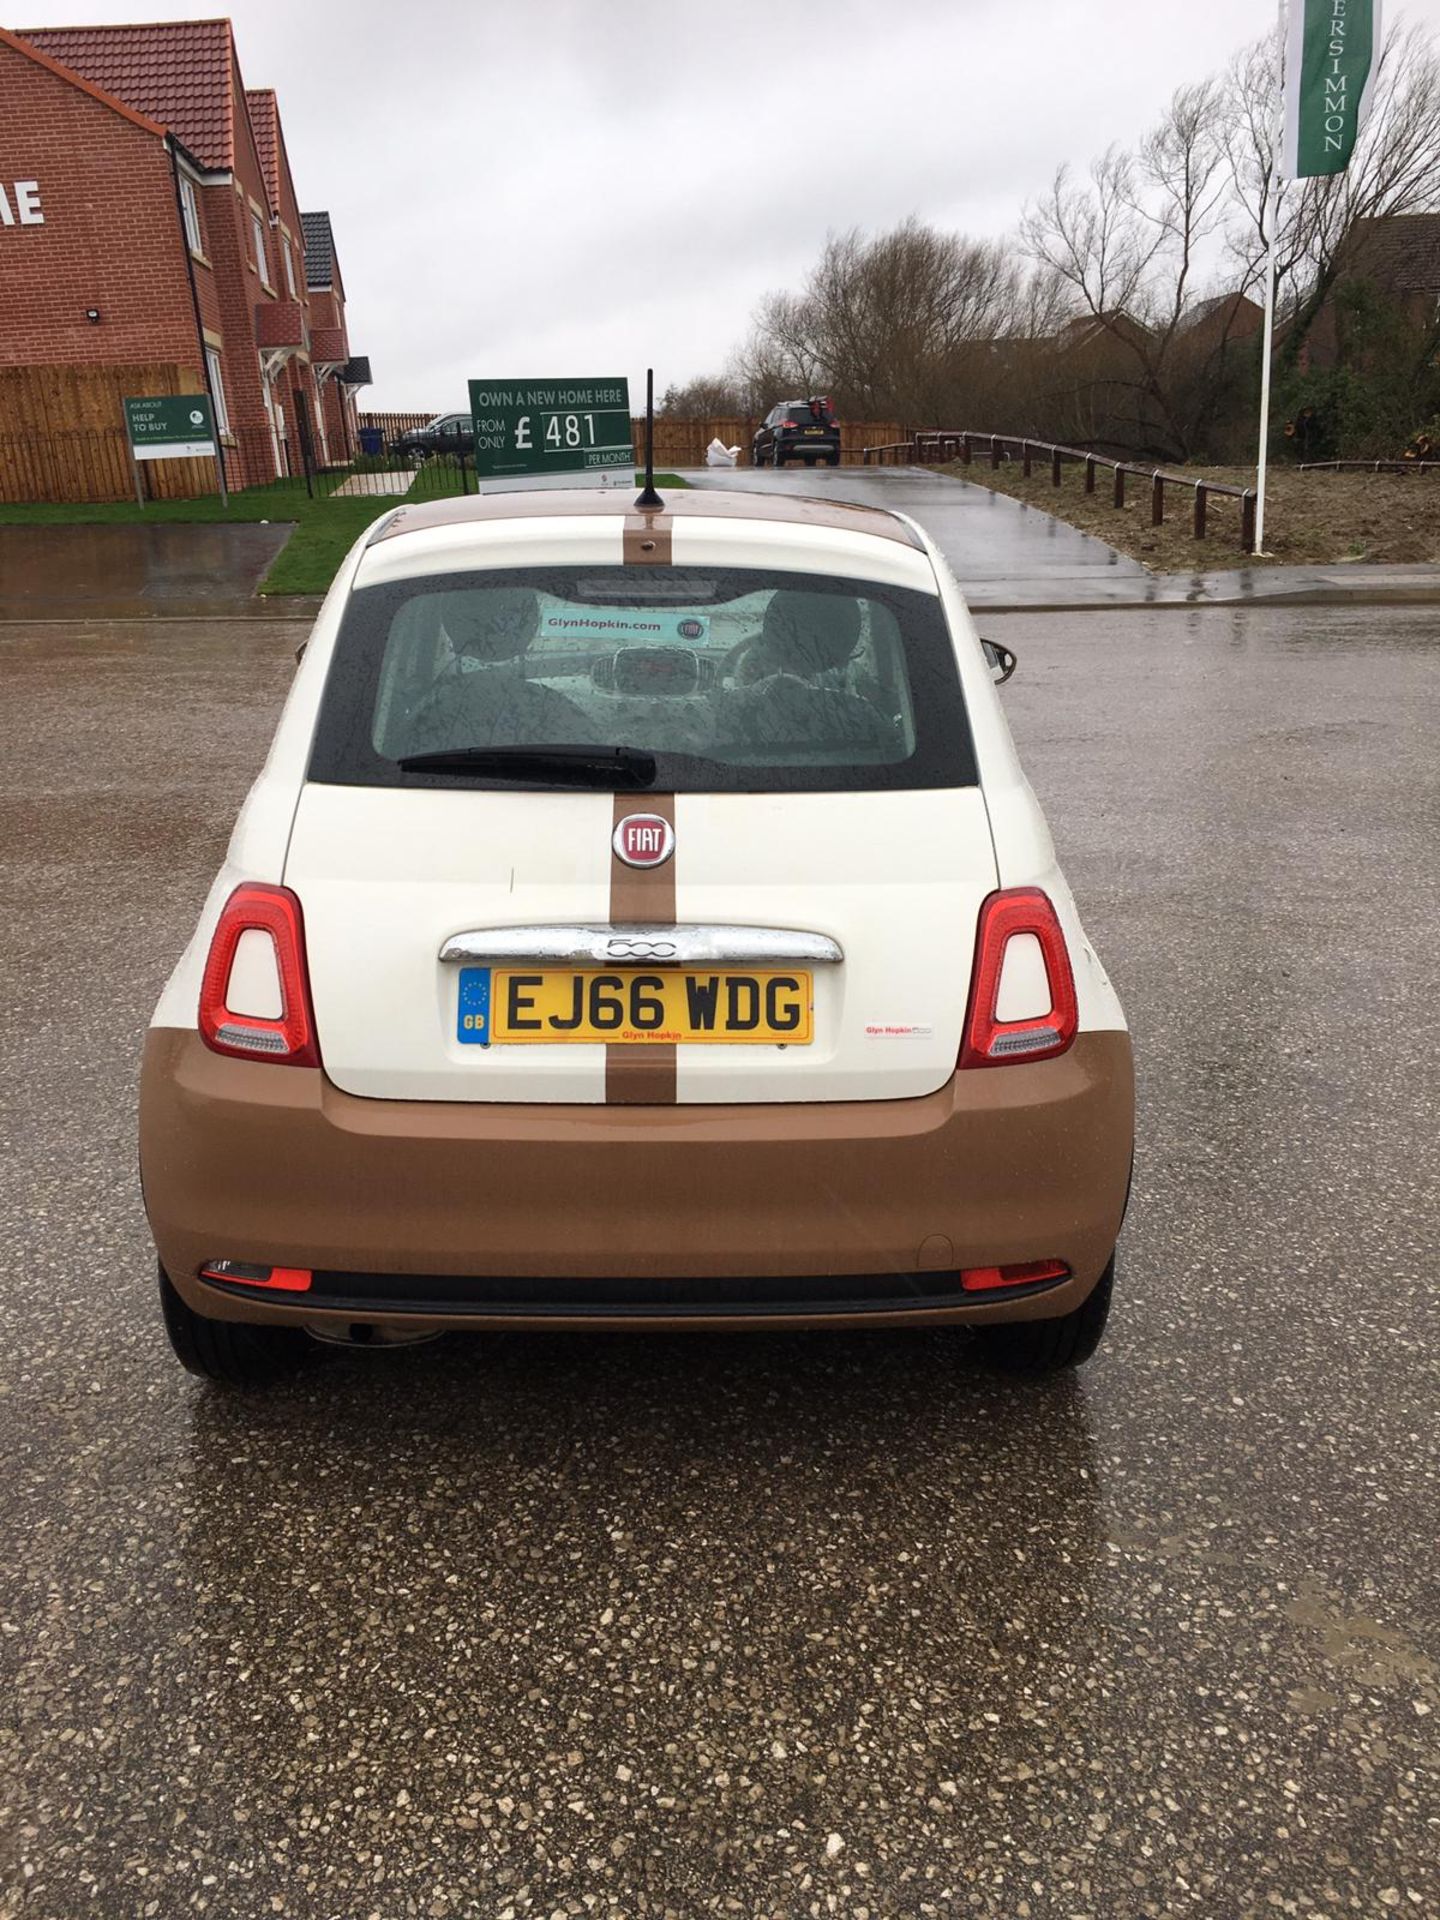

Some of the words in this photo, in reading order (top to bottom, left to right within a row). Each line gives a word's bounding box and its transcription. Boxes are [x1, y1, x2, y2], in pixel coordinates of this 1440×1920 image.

[479, 392, 512, 406] OWN
[515, 392, 525, 406] A
[527, 391, 555, 404] NEW
[558, 390, 592, 403] HOME
[595, 389, 621, 402] HERE
[132, 413, 154, 422] HELP
[133, 424, 146, 432] TO
[148, 422, 167, 431] BUY
[476, 419, 506, 433] FROM
[514, 416, 533, 449] £
[546, 414, 595, 447] 481
[478, 436, 506, 449] ONLY
[588, 454, 600, 465] PER
[548, 617, 661, 632] GlynHopkin.com
[628, 828, 662, 851] FIAT
[607, 939, 677, 957] 500
[507, 976, 665, 1030] EJ66
[685, 976, 800, 1031] WDG
[463, 1015, 485, 1030] GB
[622, 1031, 644, 1040] Glyn
[647, 1031, 682, 1041] Hopkin
[866, 1026, 884, 1034] Glyn
[885, 1026, 912, 1034] Hopkin
